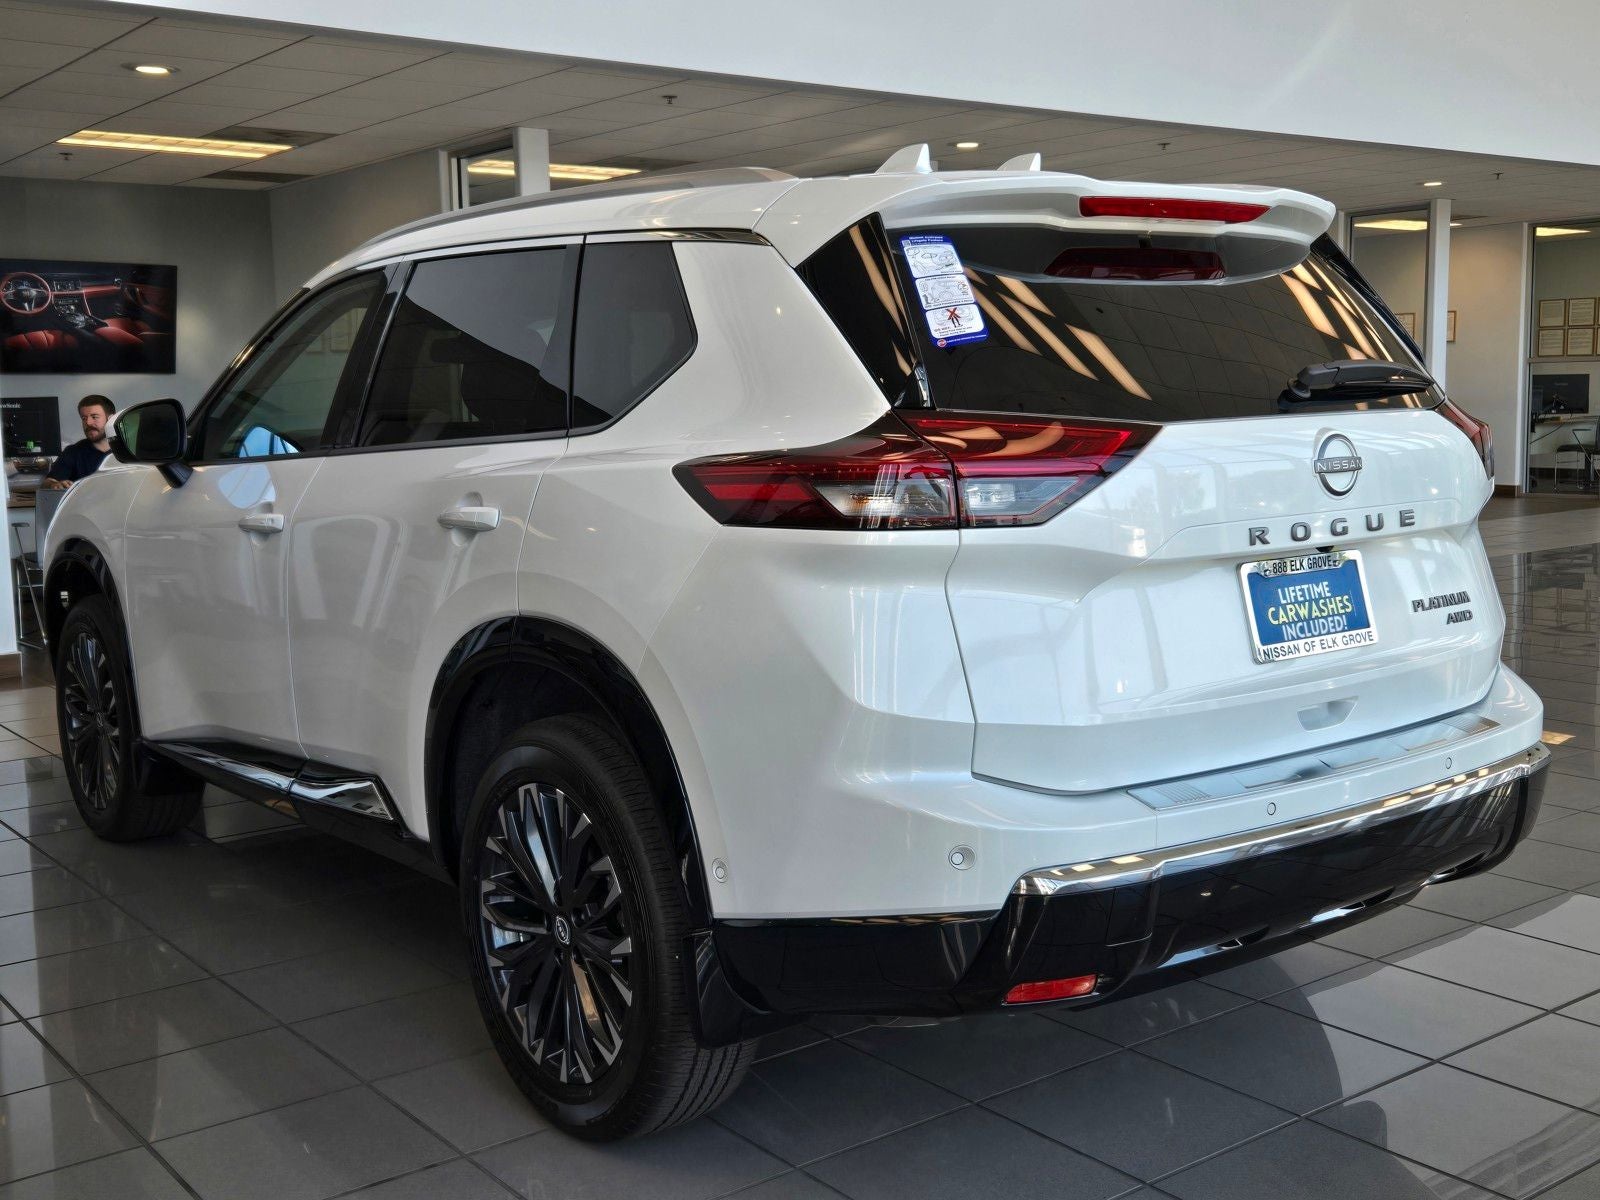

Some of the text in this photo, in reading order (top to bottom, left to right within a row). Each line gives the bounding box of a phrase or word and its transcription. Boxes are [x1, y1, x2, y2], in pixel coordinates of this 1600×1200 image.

[1317, 459, 1362, 471] NISSAN
[1248, 508, 1416, 546] ROGUE
[1272, 556, 1332, 574] 888 ELK GROVE
[1278, 581, 1331, 604] LIFETIME
[1412, 590, 1471, 613] PLATINUM
[1267, 595, 1353, 625] CARWASHES
[1446, 609, 1474, 625] AWD
[1282, 614, 1348, 641] INCLUDED!
[1262, 630, 1374, 661] NISSAN OF ELK GROVE
